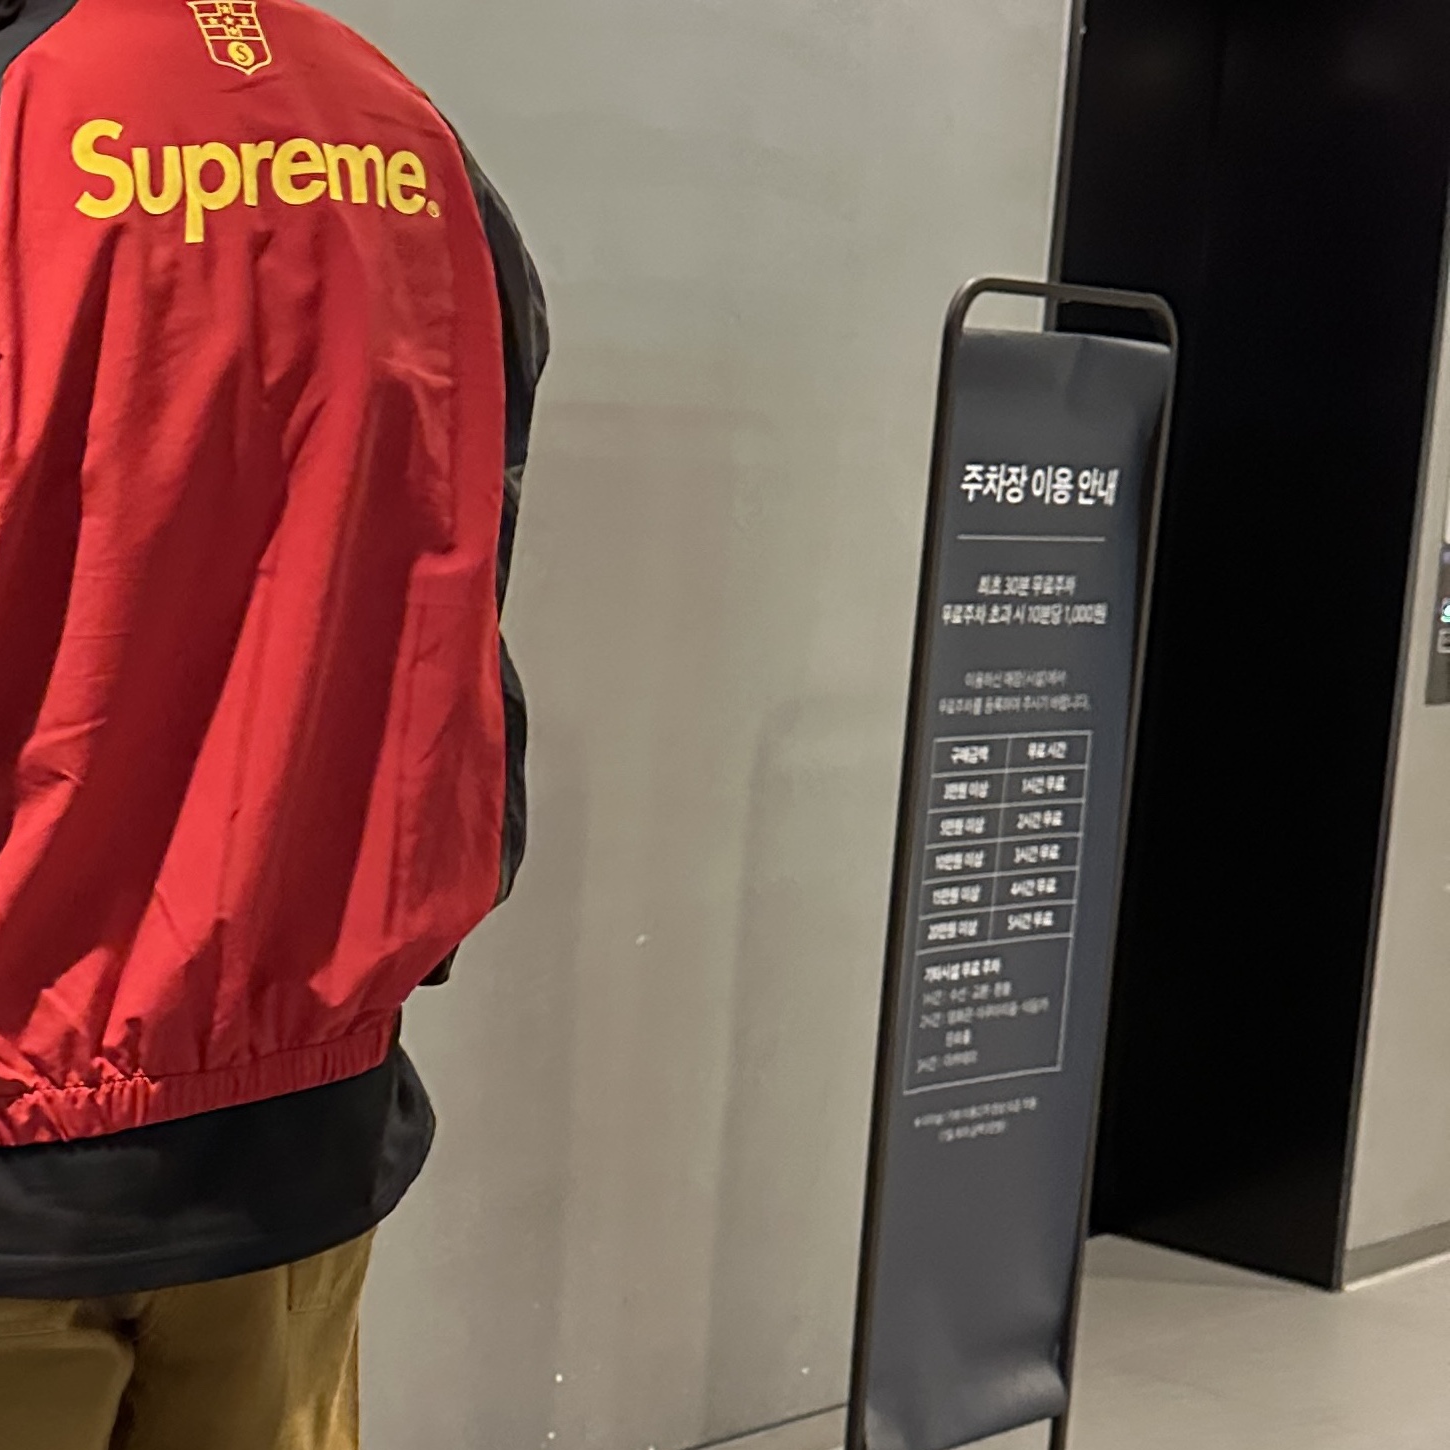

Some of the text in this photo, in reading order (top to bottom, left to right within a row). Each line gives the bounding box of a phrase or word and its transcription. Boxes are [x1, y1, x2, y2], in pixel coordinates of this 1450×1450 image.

[71, 119, 426, 243] Supreme
[960, 463, 1121, 507] 주차장 이용 안내
[941, 603, 987, 626] 무료주차
[987, 603, 1013, 626] 초과
[1013, 603, 1027, 626] 시
